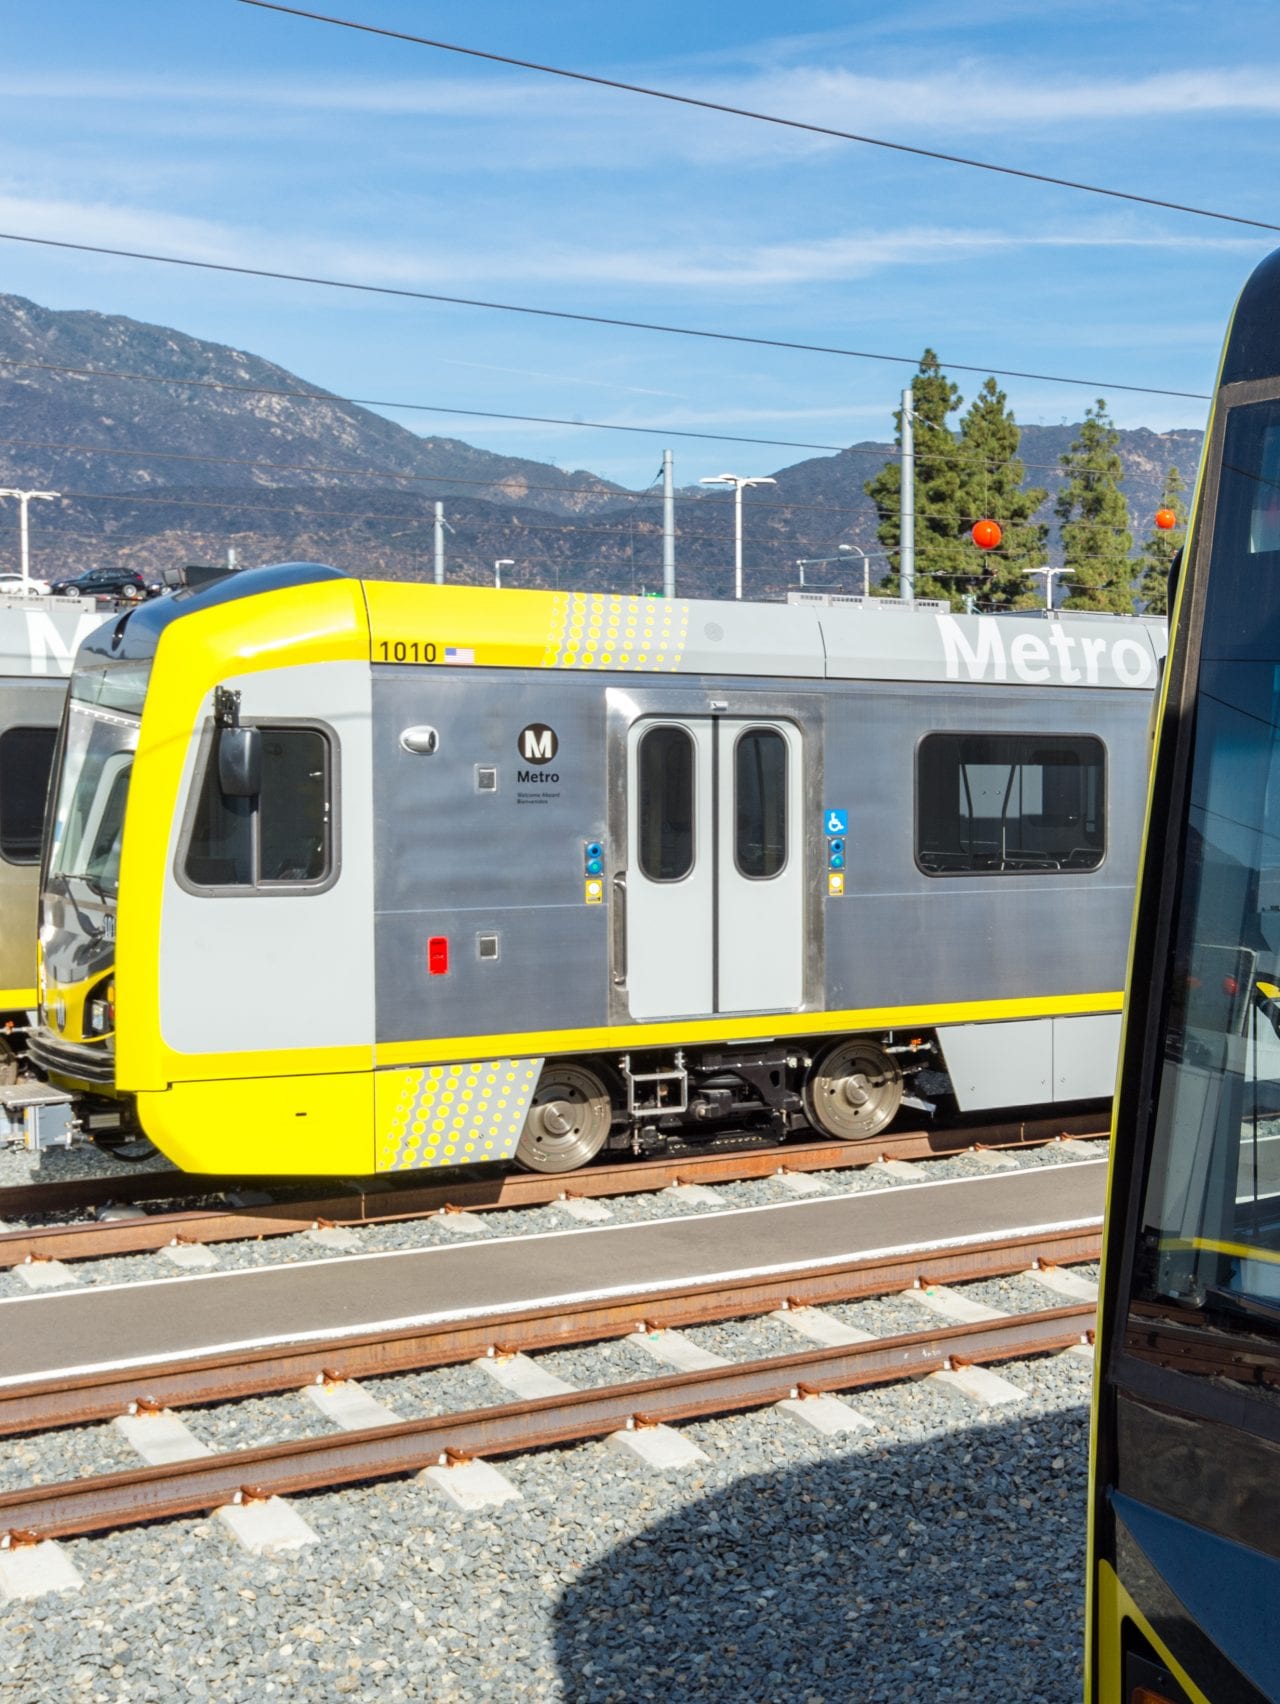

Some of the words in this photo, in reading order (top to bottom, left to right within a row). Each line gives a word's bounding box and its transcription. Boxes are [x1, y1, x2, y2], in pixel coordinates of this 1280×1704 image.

[380, 641, 436, 663] 1010
[936, 617, 1153, 685] Metro
[523, 728, 554, 761] M
[517, 770, 560, 783] Metro
